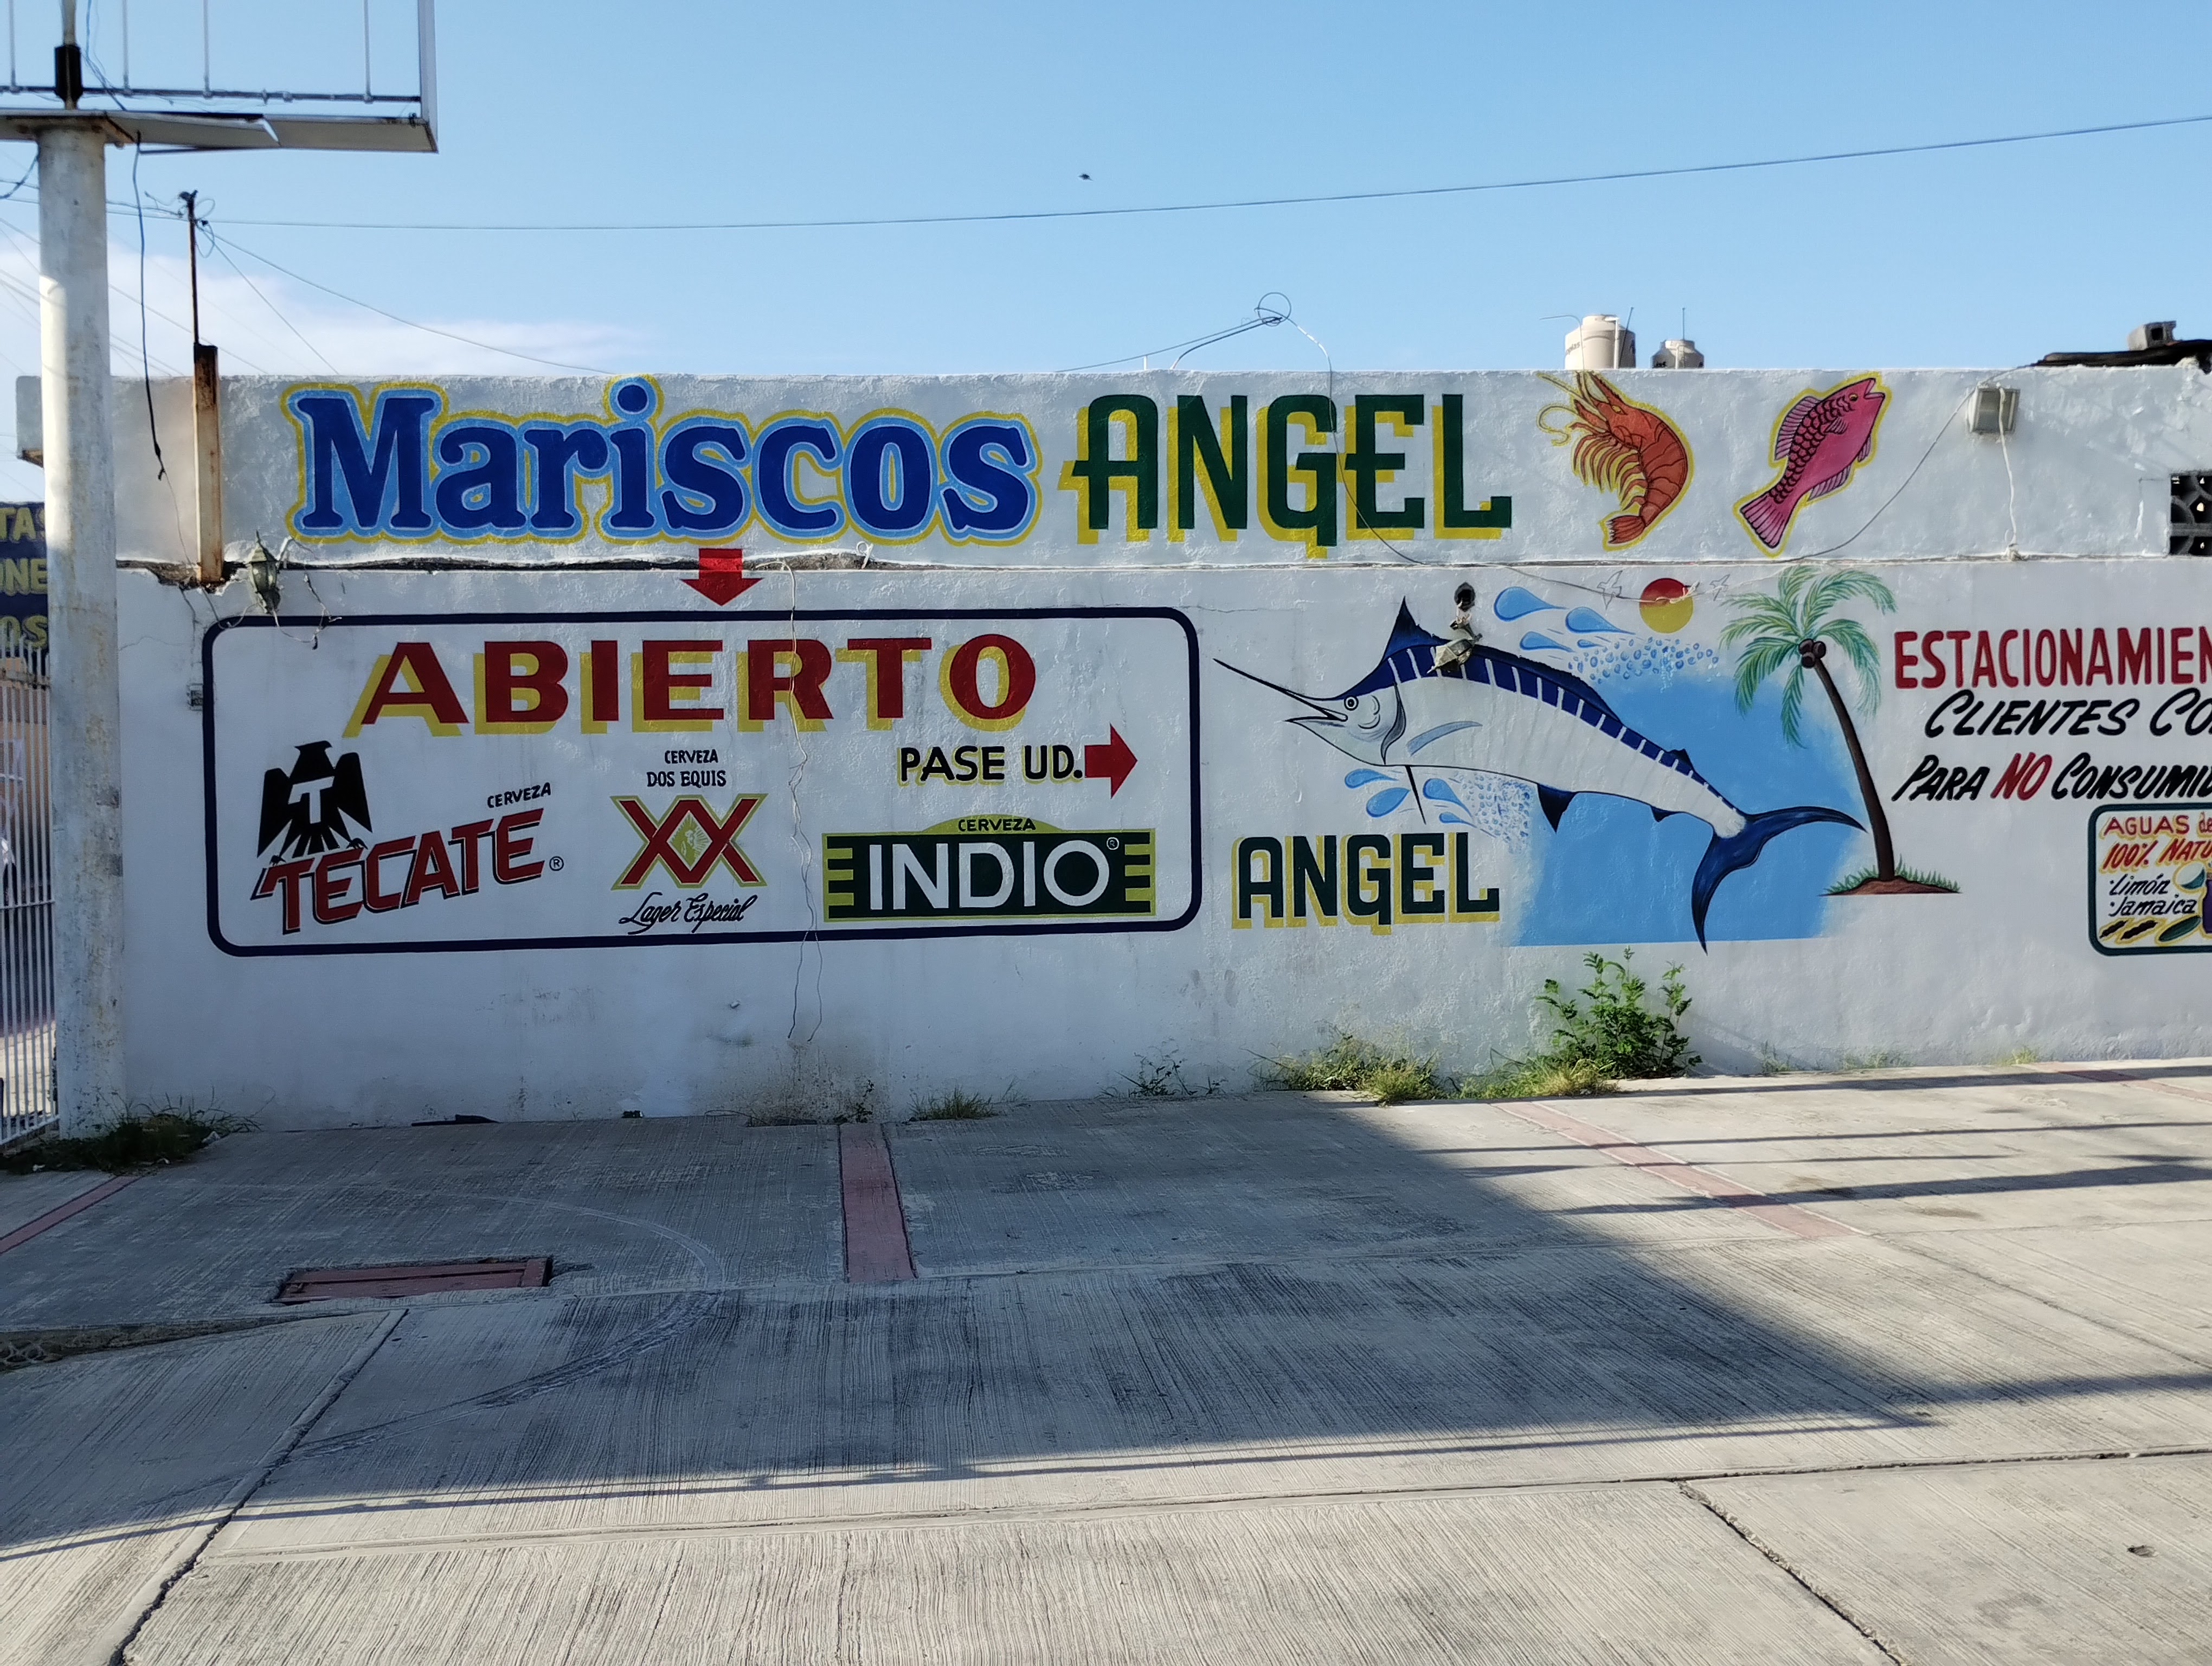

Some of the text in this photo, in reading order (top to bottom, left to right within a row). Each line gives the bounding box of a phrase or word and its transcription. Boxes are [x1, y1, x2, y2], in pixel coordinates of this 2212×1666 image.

[289, 380, 1513, 547] Mariscos ANGEL
[358, 633, 1036, 729] ABIERTO
[1925, 687, 2212, 738] CLIENTES CO
[646, 769, 727, 788] DOS EQUIS
[664, 749, 718, 765] CERVEZA
[900, 745, 1083, 782] PASE UD.
[1892, 754, 1990, 801] PARA
[1990, 752, 2053, 801] NO
[487, 782, 551, 809] CERVEZA
[612, 793, 768, 890] XX
[957, 818, 1036, 832] CERVEZA
[2104, 815, 2190, 836] AGUAS
[250, 808, 546, 935] TECATE
[869, 840, 1110, 911] INDIO
[2102, 840, 2159, 870] 100%
[1236, 832, 1500, 928] ANGEL
[618, 892, 758, 935] Lager Especial
